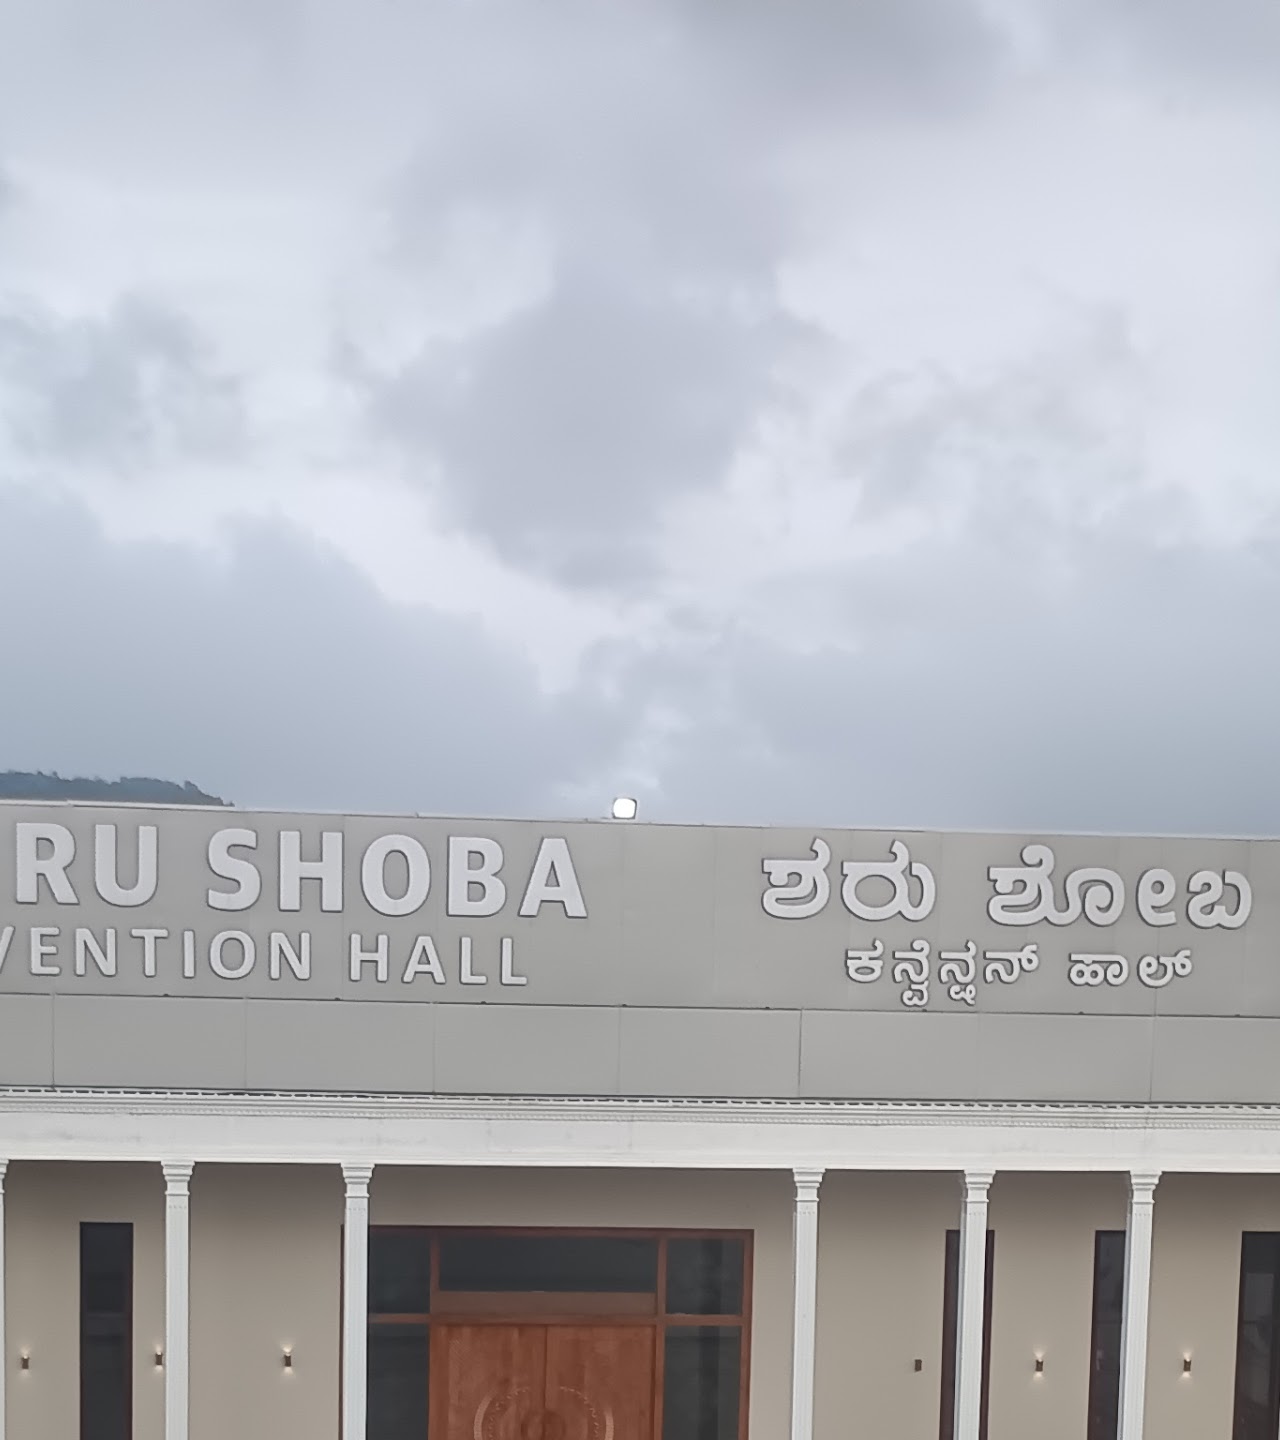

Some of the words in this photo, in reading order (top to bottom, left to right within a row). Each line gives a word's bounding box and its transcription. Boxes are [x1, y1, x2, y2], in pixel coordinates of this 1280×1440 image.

[206, 829, 588, 918] SHOBA
[761, 837, 937, 922] ಶರು
[986, 844, 1253, 930] ಶೋಬ
[349, 934, 528, 986] HALL
[1066, 949, 1194, 988] ಹಾಲ್
